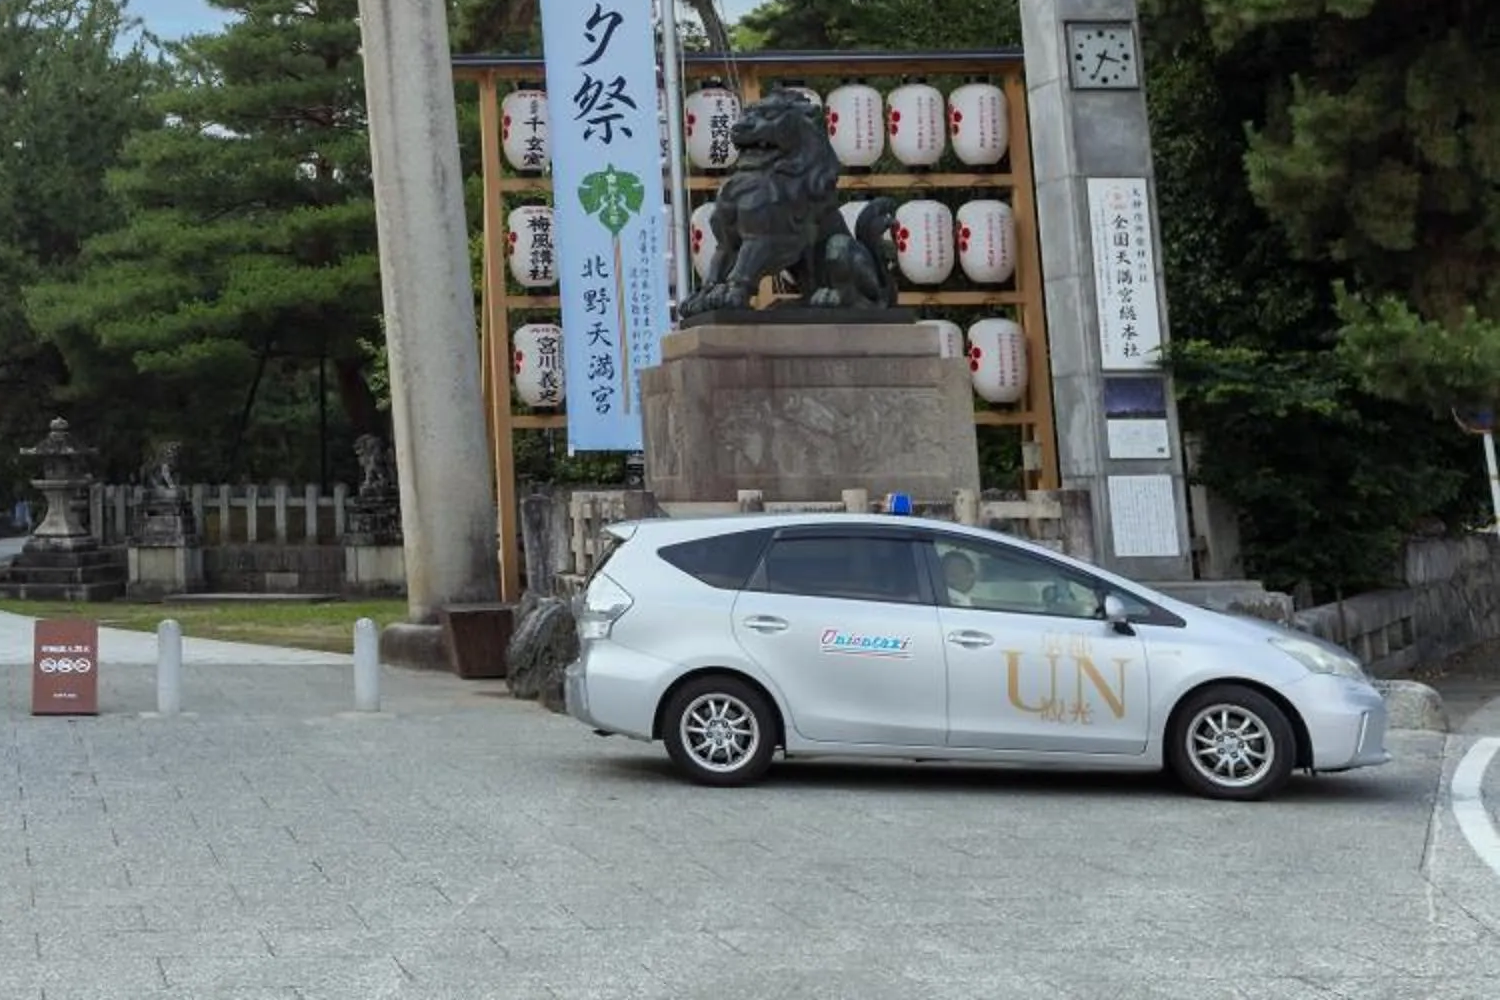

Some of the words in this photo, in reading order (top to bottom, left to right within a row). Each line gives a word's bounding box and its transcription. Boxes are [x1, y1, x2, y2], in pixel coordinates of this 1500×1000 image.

[581, 254, 616, 414] 北野天満宮
[1002, 650, 1134, 720] UN
